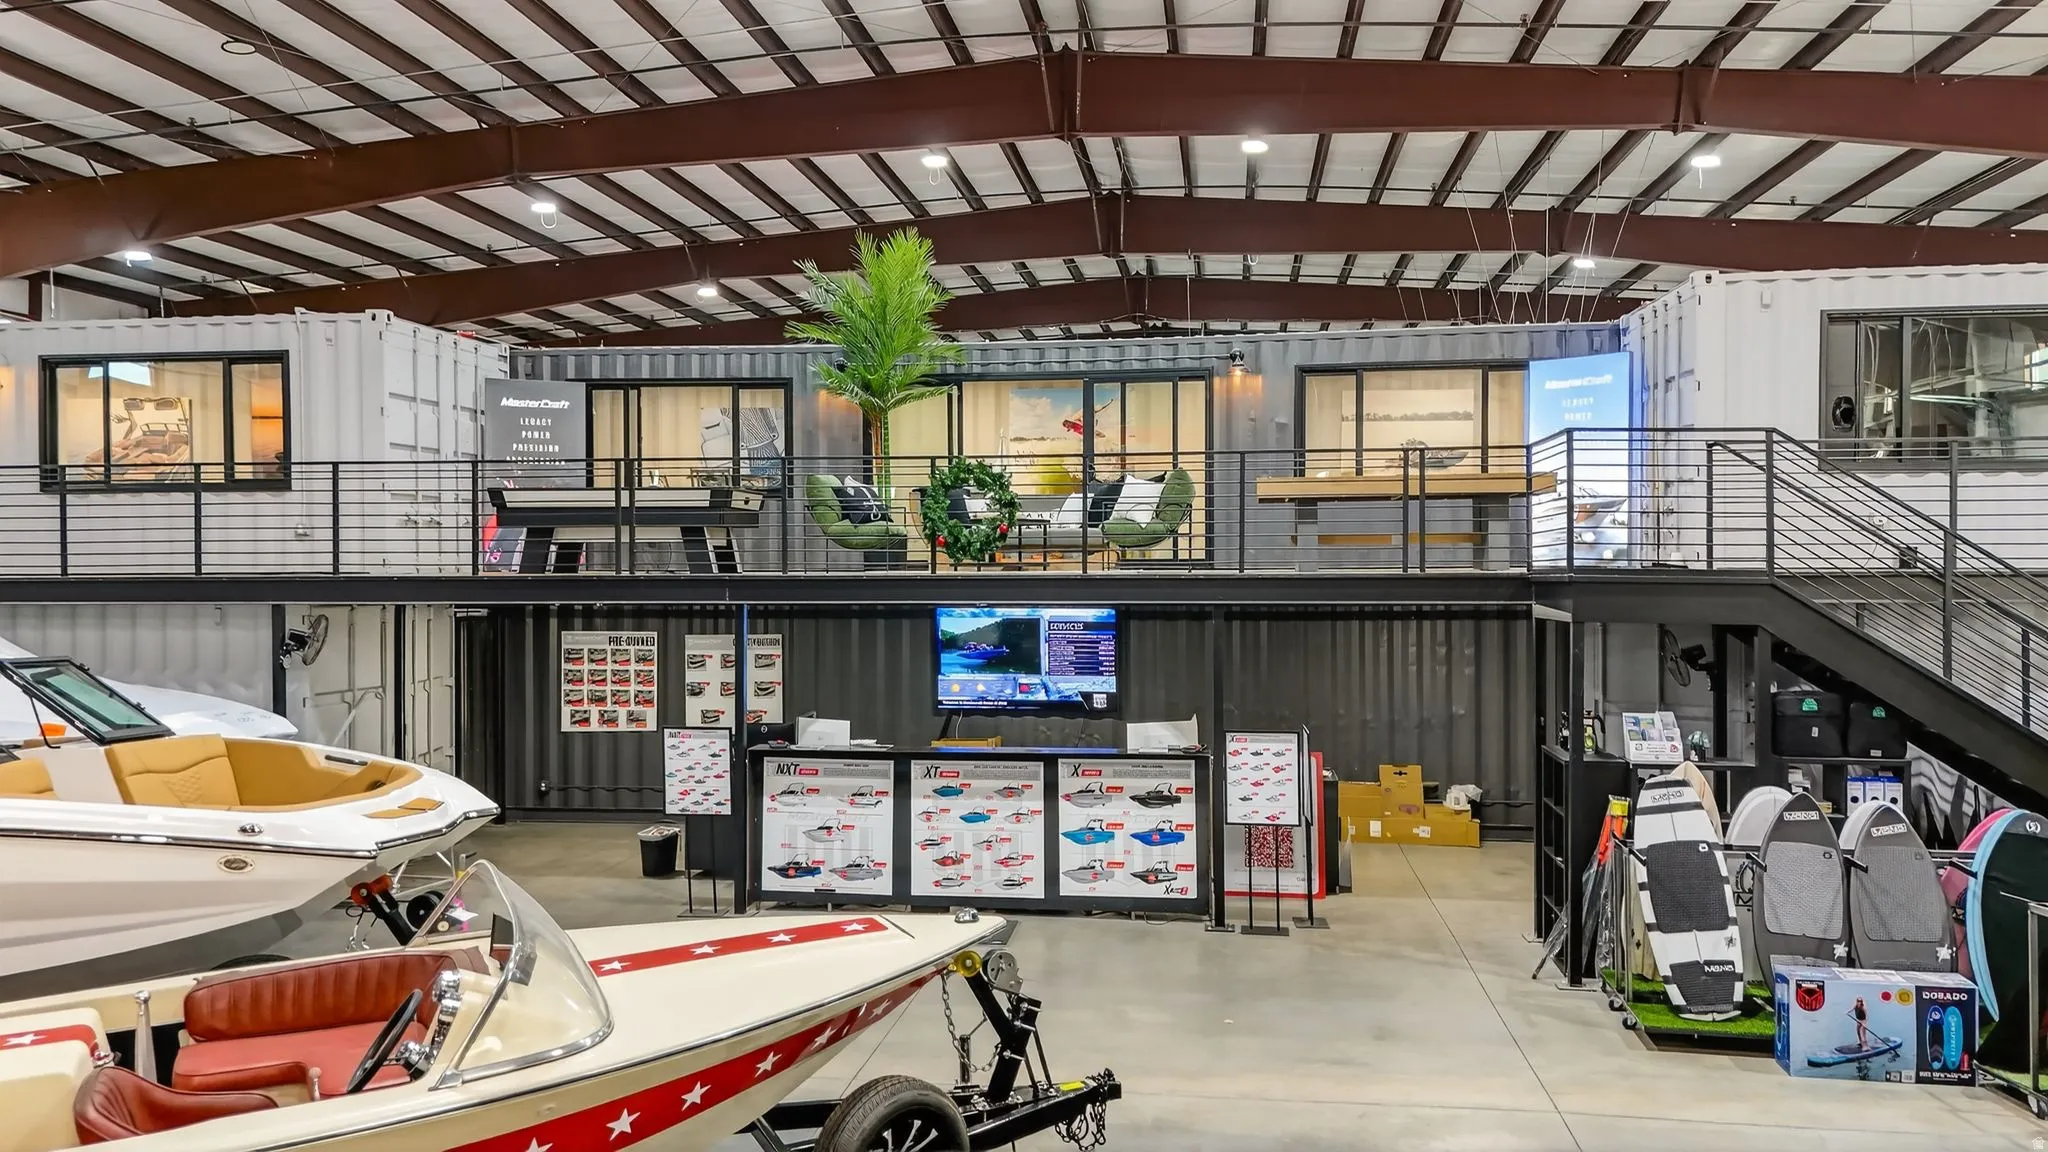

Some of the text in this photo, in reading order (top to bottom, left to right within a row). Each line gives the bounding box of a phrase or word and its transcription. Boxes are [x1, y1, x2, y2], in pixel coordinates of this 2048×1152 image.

[501, 397, 569, 409] MasterCraft
[520, 417, 552, 426] LEGACY
[522, 430, 551, 439] POWER
[776, 762, 800, 777] NXT
[923, 764, 941, 779] XT
[1071, 763, 1081, 778] X
